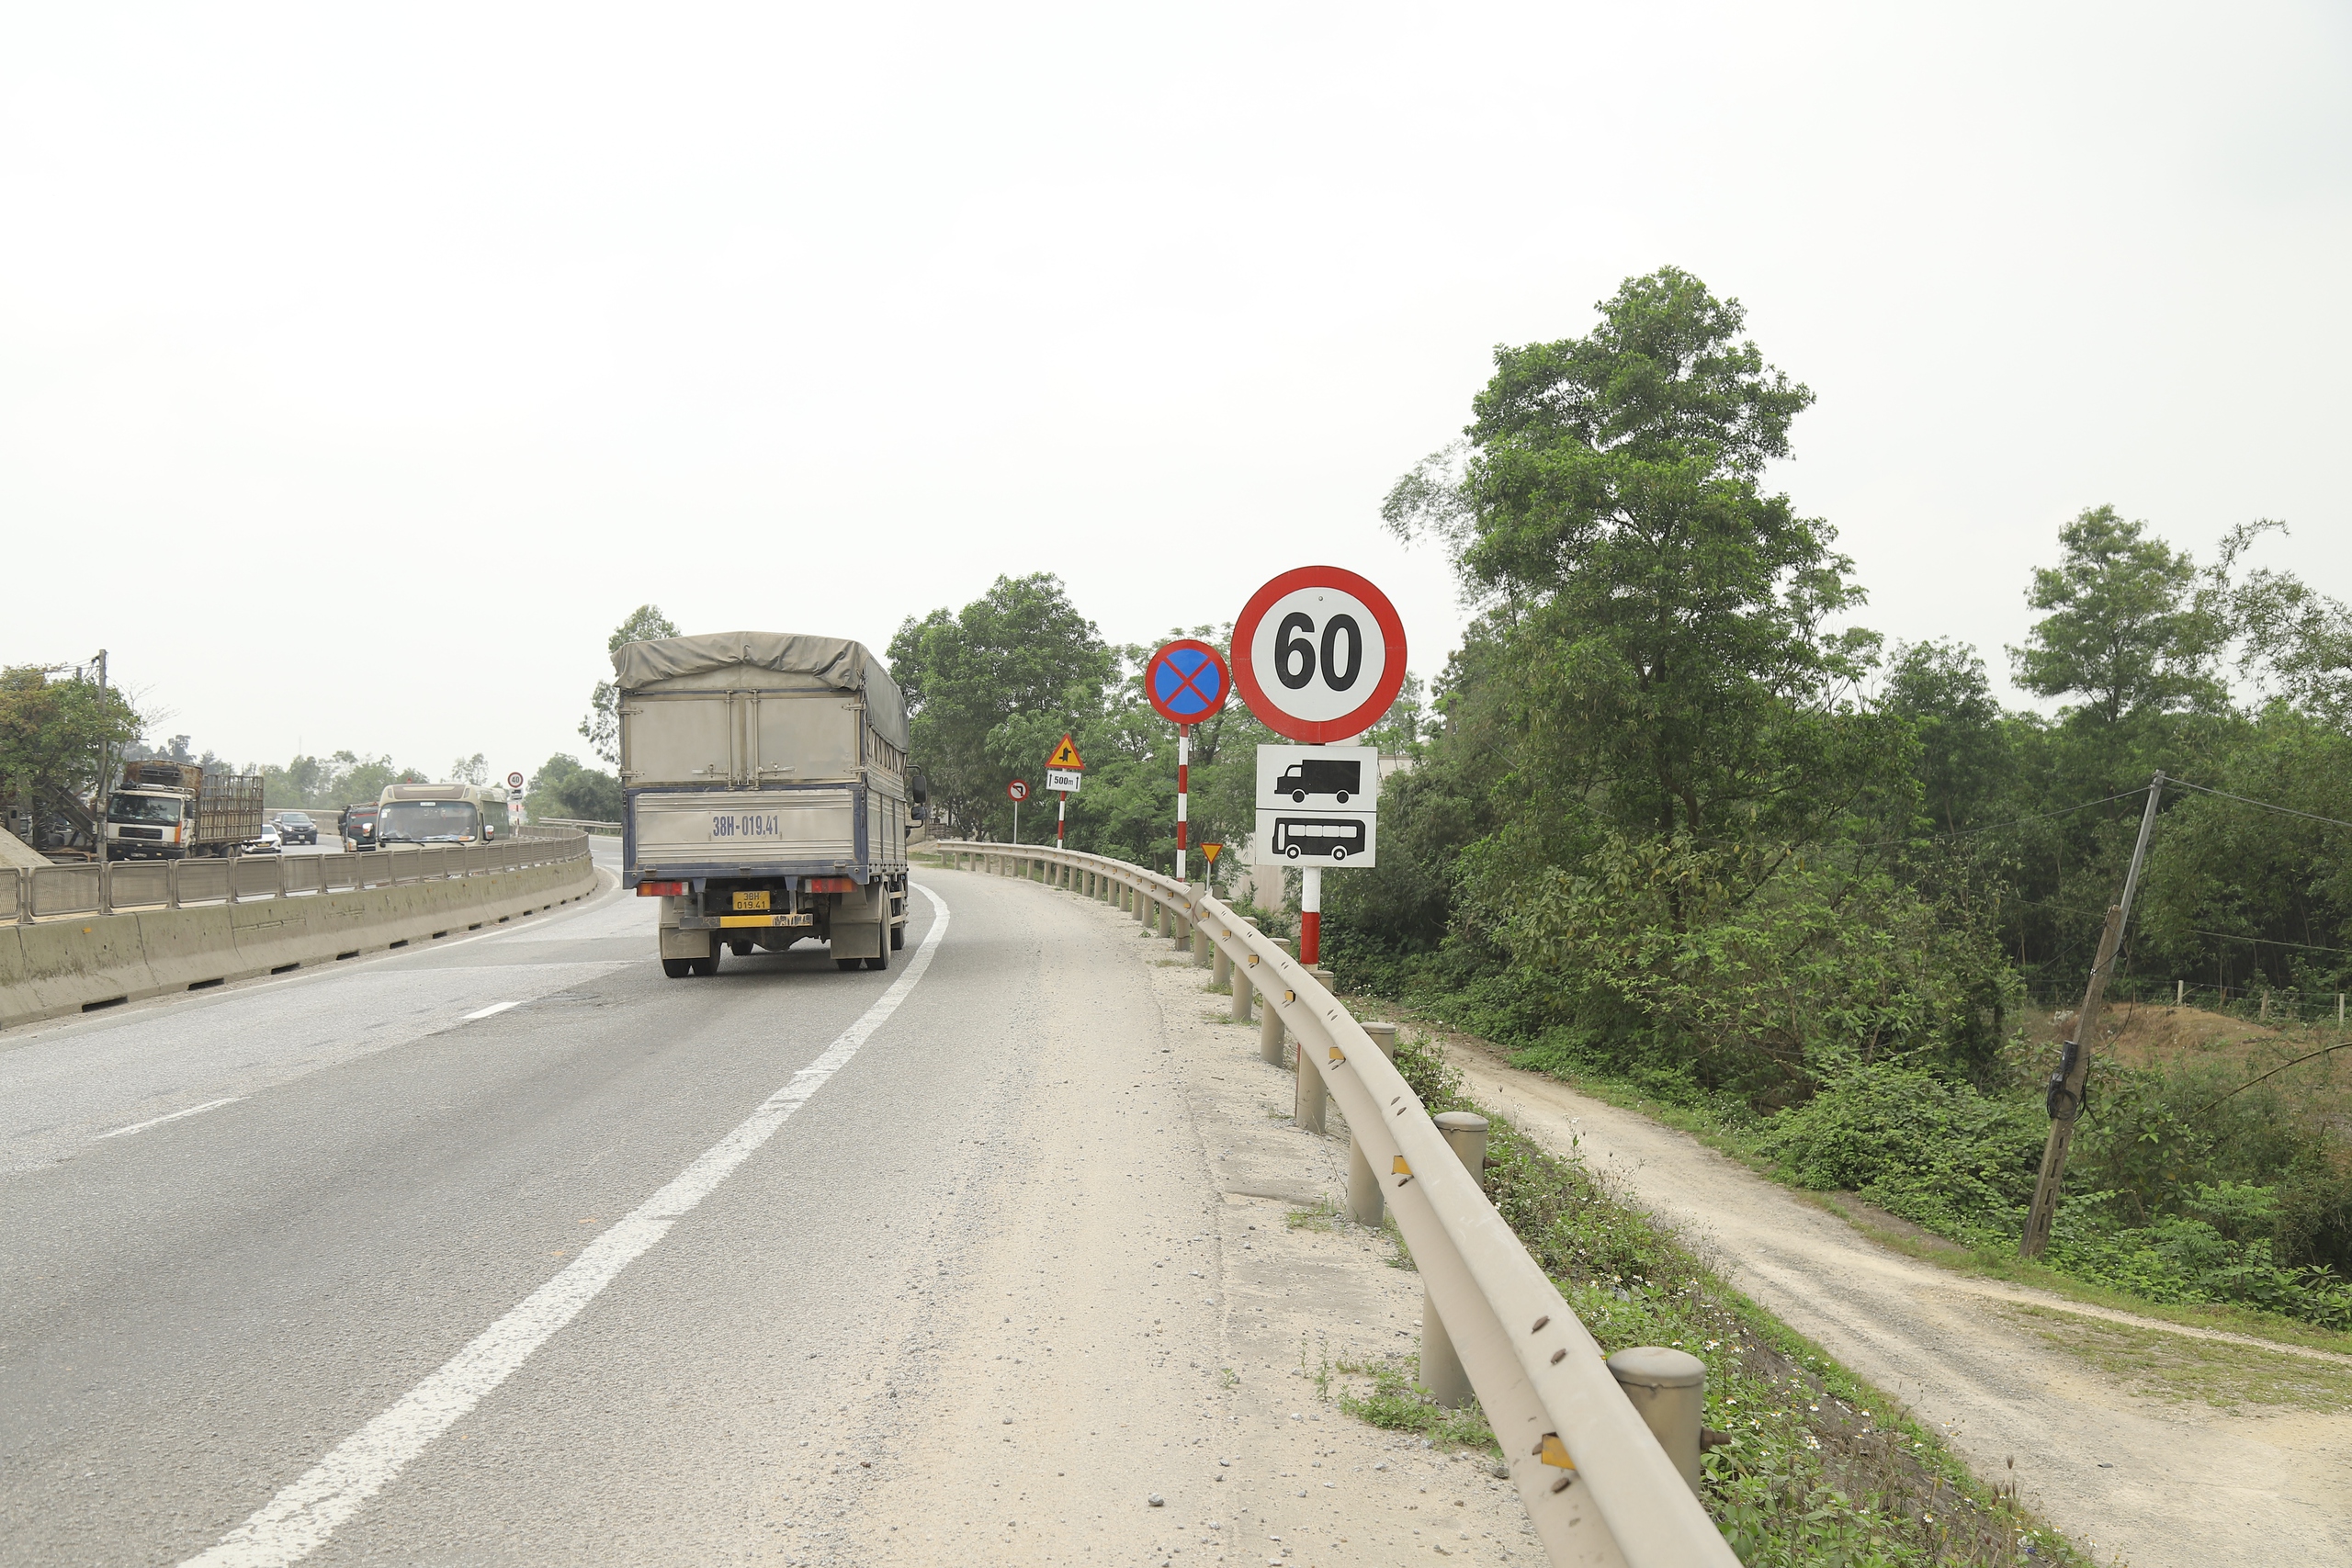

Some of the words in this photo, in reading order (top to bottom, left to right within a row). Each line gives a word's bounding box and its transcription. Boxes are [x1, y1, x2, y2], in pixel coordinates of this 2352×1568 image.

[1274, 611, 1363, 692] 60
[511, 775, 520, 784] 40
[1054, 775, 1074, 786] 500m
[713, 815, 778, 836] 38H-019.41
[743, 892, 760, 900] 38H
[737, 901, 765, 909] 019.41
